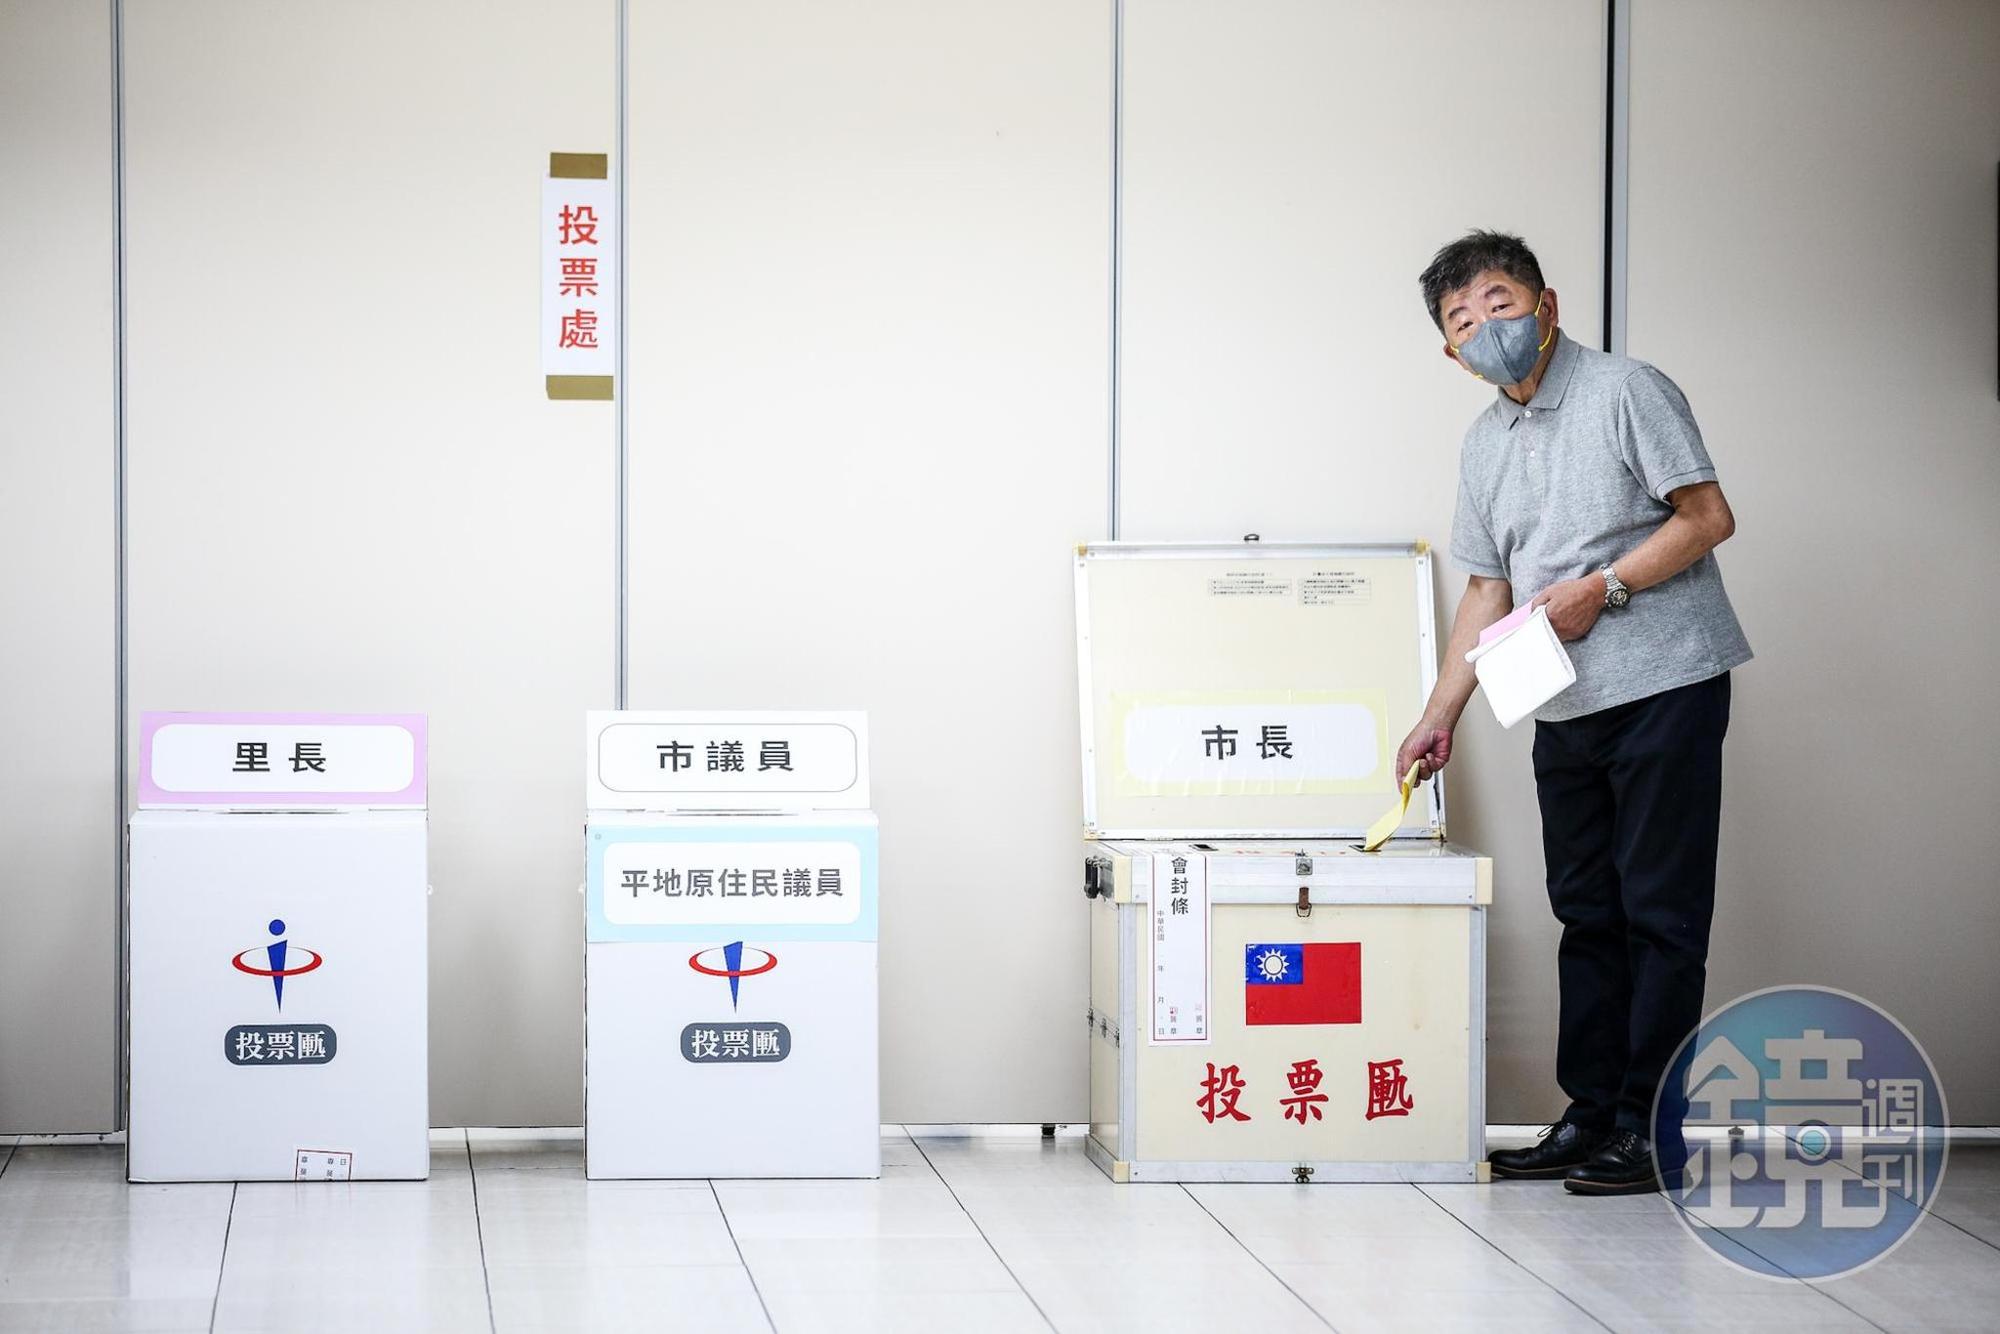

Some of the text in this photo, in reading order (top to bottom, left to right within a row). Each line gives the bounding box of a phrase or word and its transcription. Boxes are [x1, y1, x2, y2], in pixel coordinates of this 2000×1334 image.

[559, 204, 599, 349] 投票處
[232, 742, 327, 773] 里長
[656, 740, 794, 773] 市議員
[1201, 724, 1293, 761] 市長
[620, 867, 844, 898] 平地原住民議員
[1171, 856, 1189, 915] 會封條
[235, 1031, 327, 1060] 投票匭
[691, 1028, 781, 1058] 投票匭
[1196, 1058, 1414, 1125] 投票匭
